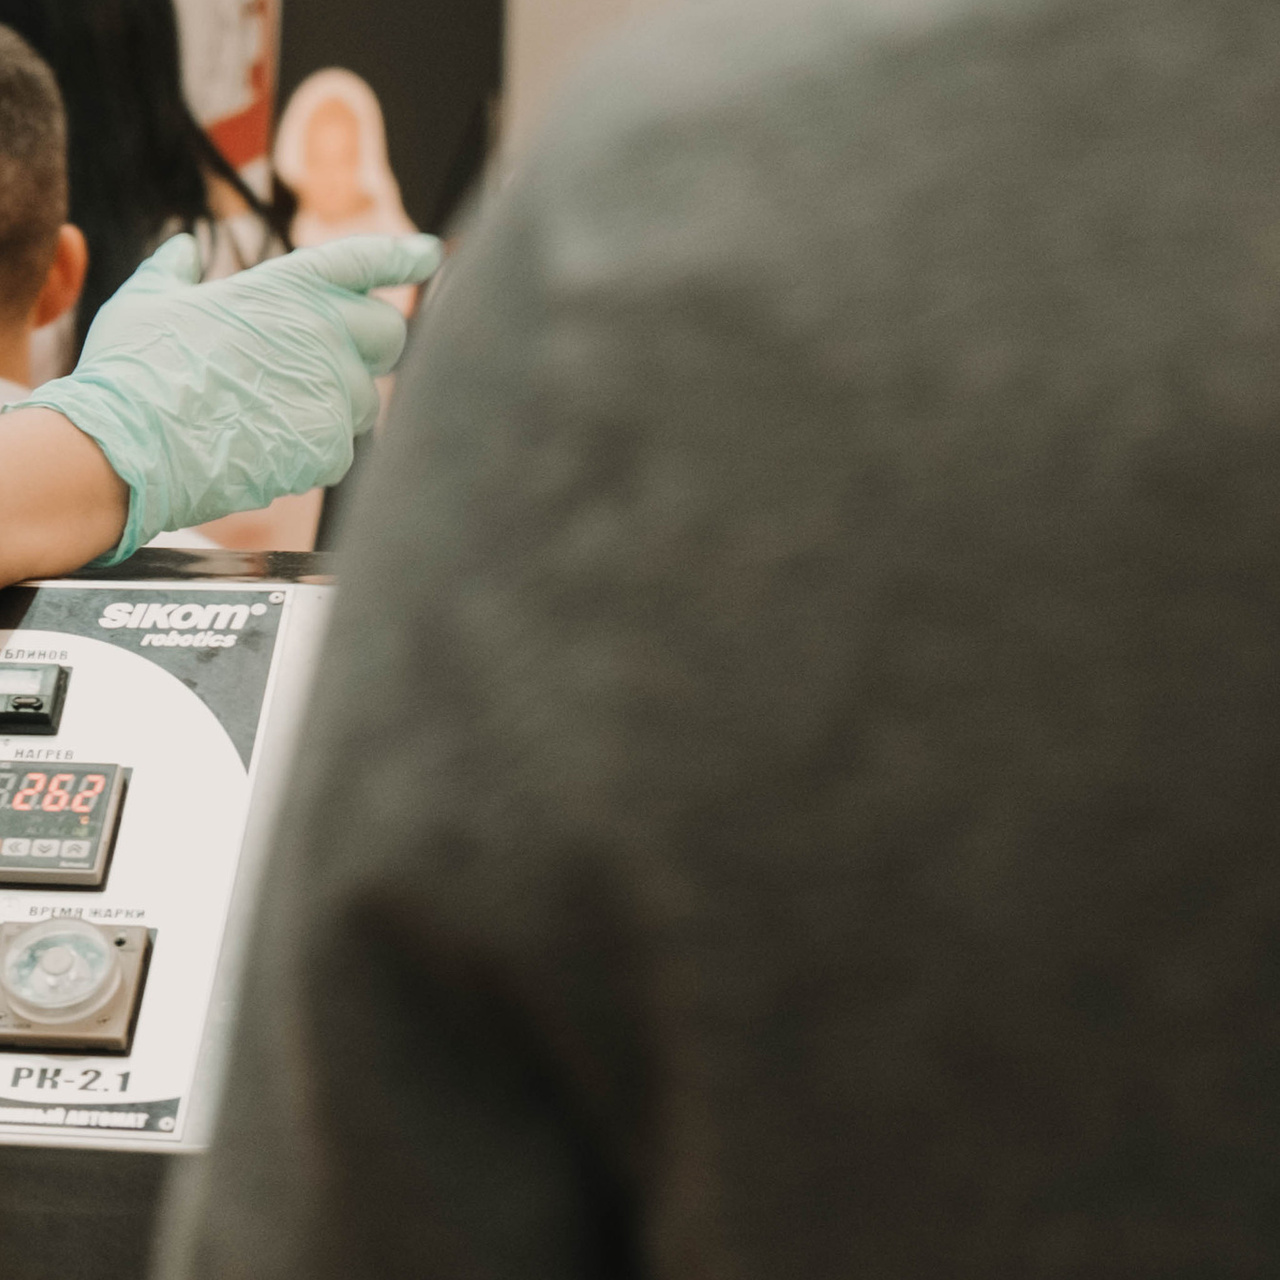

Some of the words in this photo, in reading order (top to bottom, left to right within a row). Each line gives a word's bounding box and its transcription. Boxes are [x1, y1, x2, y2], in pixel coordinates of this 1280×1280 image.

[140, 630, 238, 648] robotics
[4, 648, 68, 660] БЛИНОВ
[14, 748, 74, 760] НАГРЕВ
[11, 772, 106, 813] 262
[29, 906, 84, 918] ВРЕМЯ
[88, 908, 145, 919] ЖАРКИ
